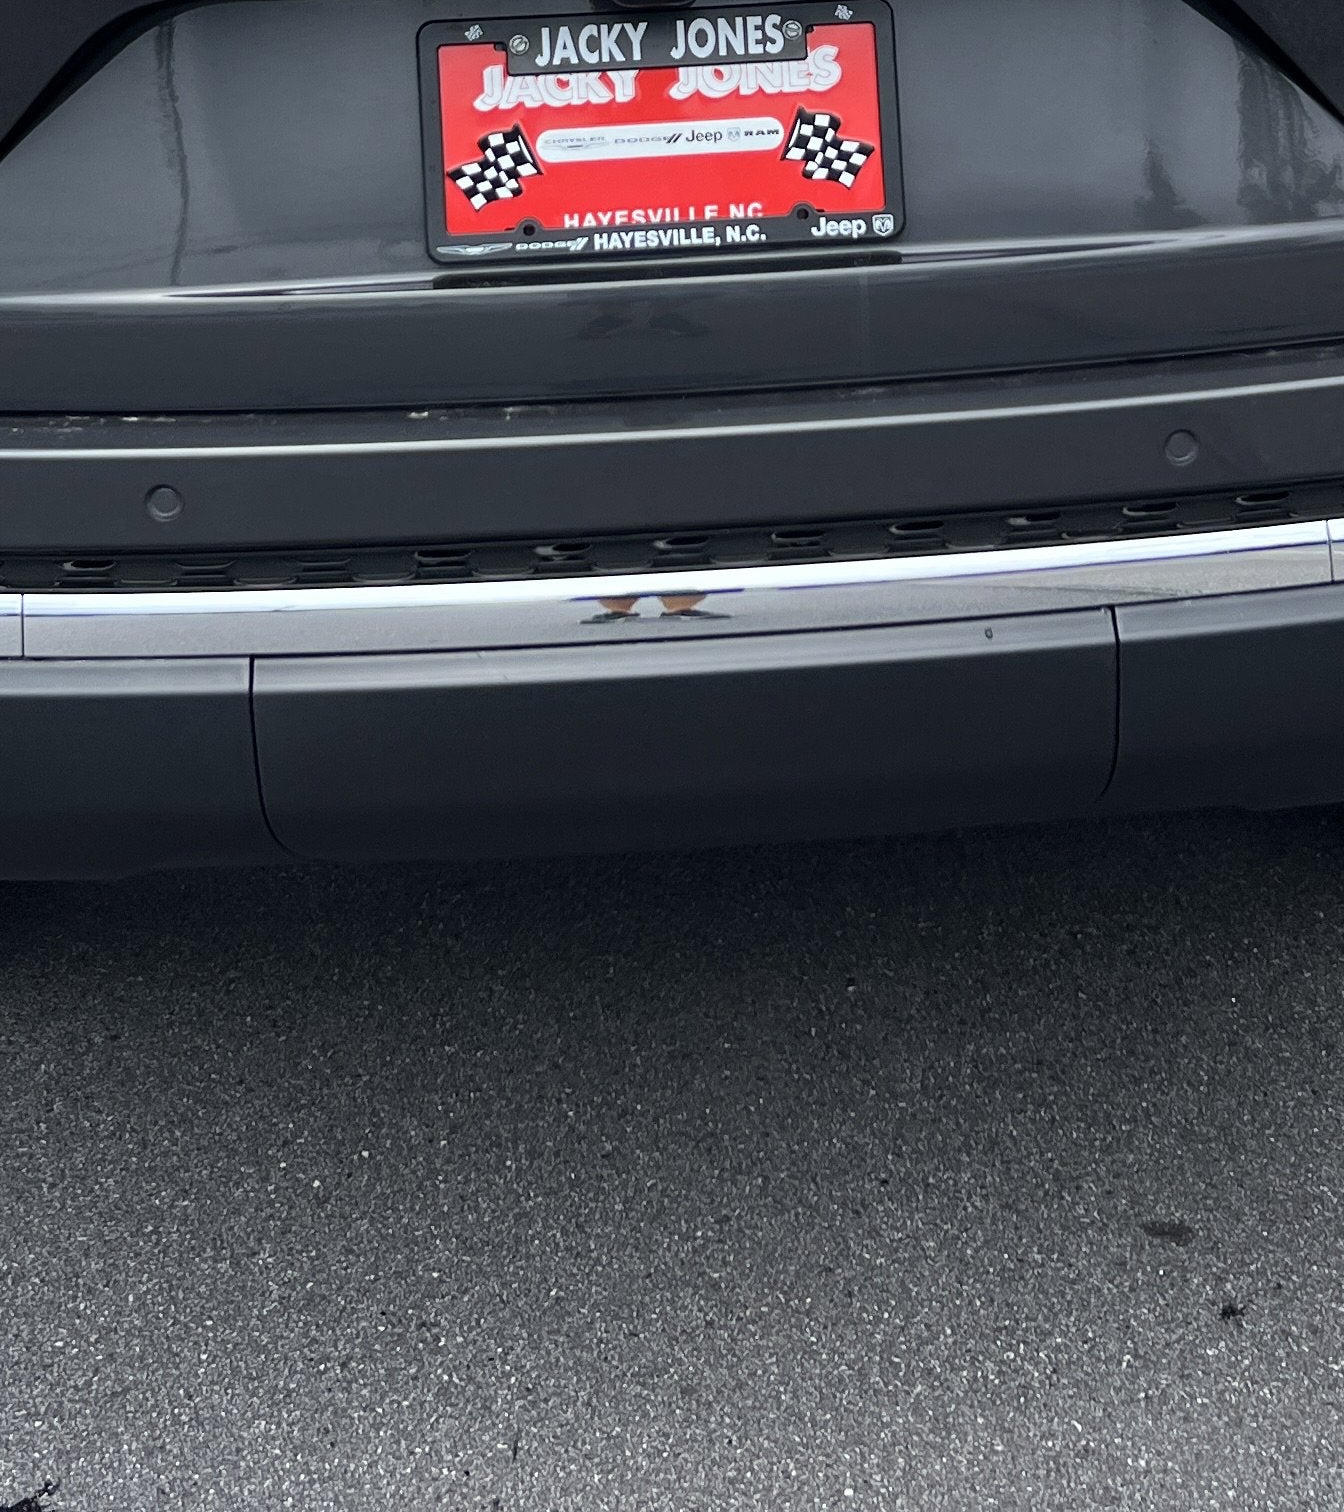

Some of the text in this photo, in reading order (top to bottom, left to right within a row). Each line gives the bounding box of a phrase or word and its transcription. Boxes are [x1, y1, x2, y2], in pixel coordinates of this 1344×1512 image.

[534, 14, 785, 67] JACKY JONES
[473, 44, 843, 112] JACKY JONES
[685, 129, 723, 144] Jeep
[744, 129, 780, 137] RAM
[593, 224, 767, 250] HAYESVILLE, N.C.
[810, 217, 867, 238] Jeep
